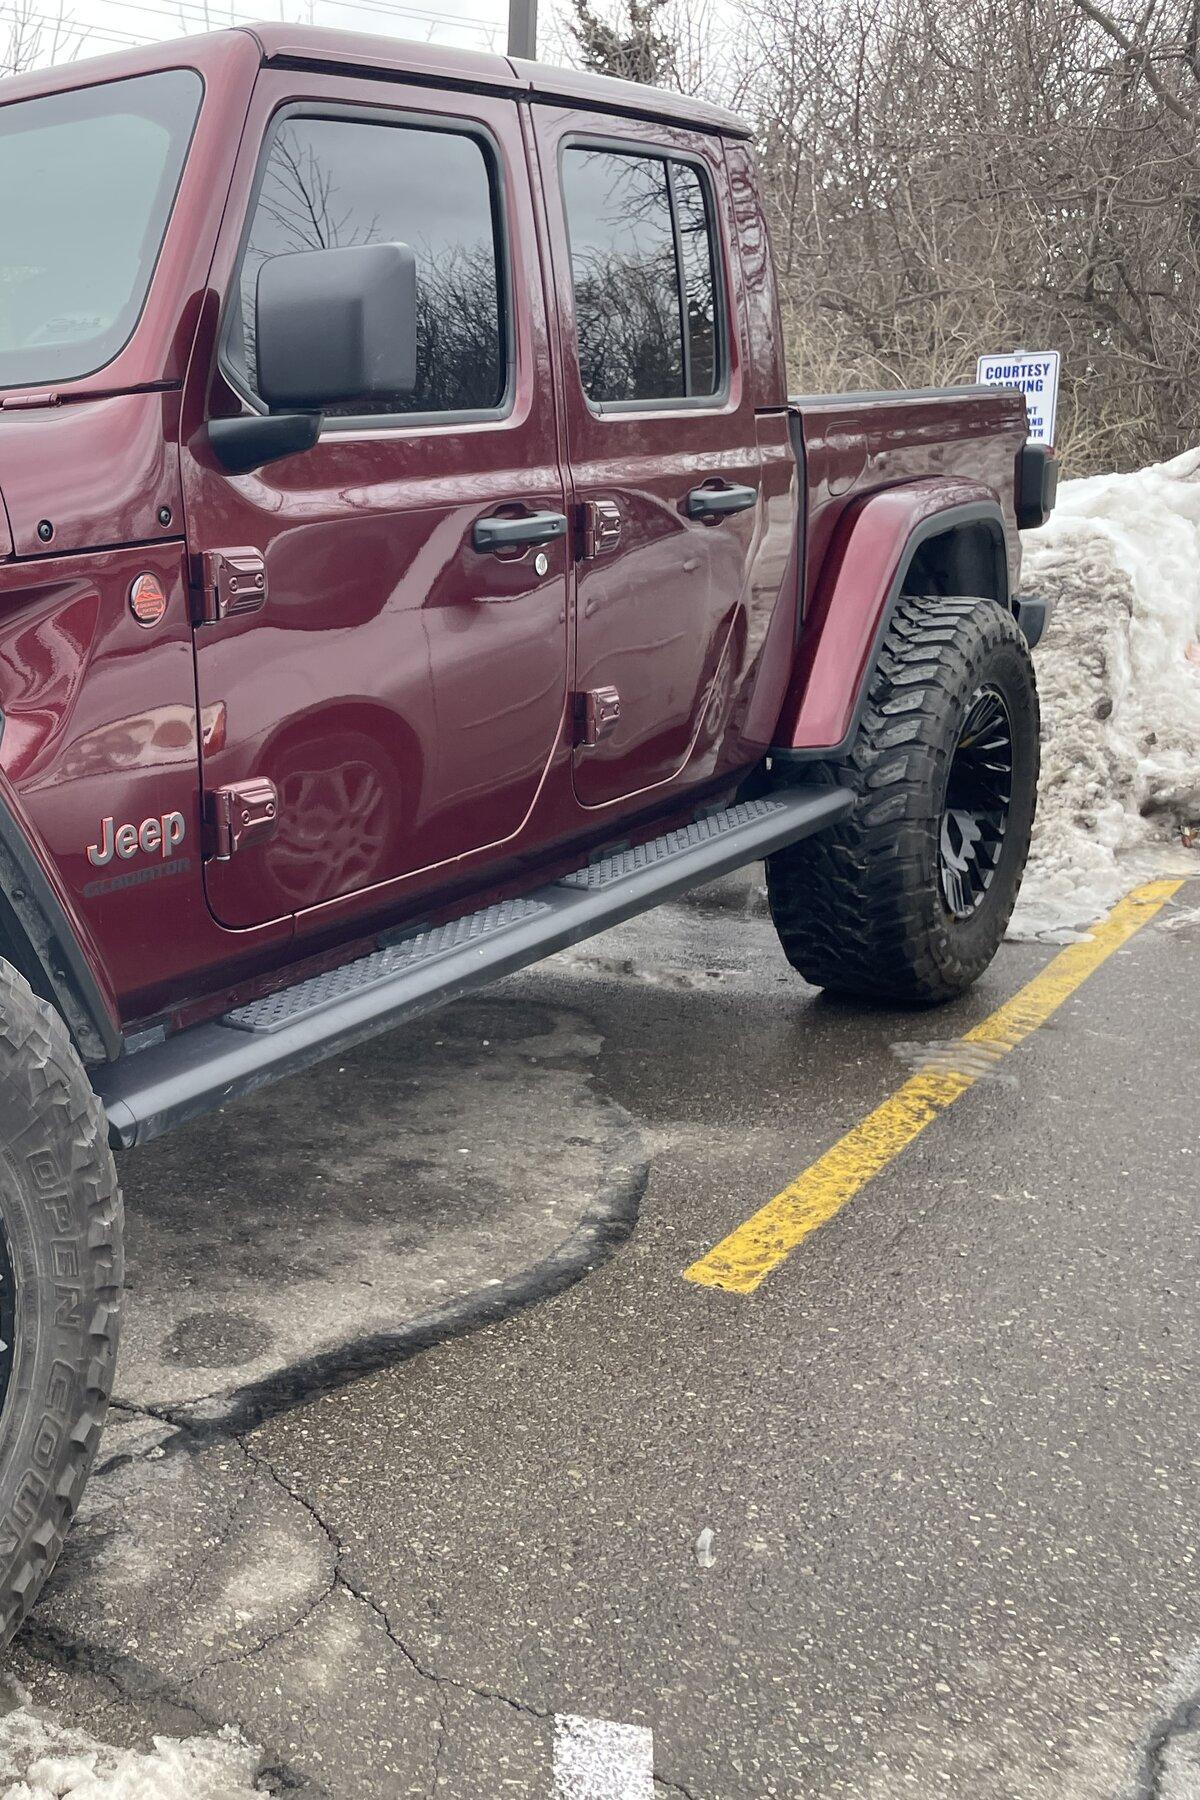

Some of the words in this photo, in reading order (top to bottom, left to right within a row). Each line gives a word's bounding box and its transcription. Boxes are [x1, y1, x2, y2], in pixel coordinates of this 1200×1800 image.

[986, 363, 1050, 380] COURTESY
[990, 379, 1043, 393] KING
[87, 811, 187, 867] Jeep
[26, 1148, 82, 1329] OPEN
